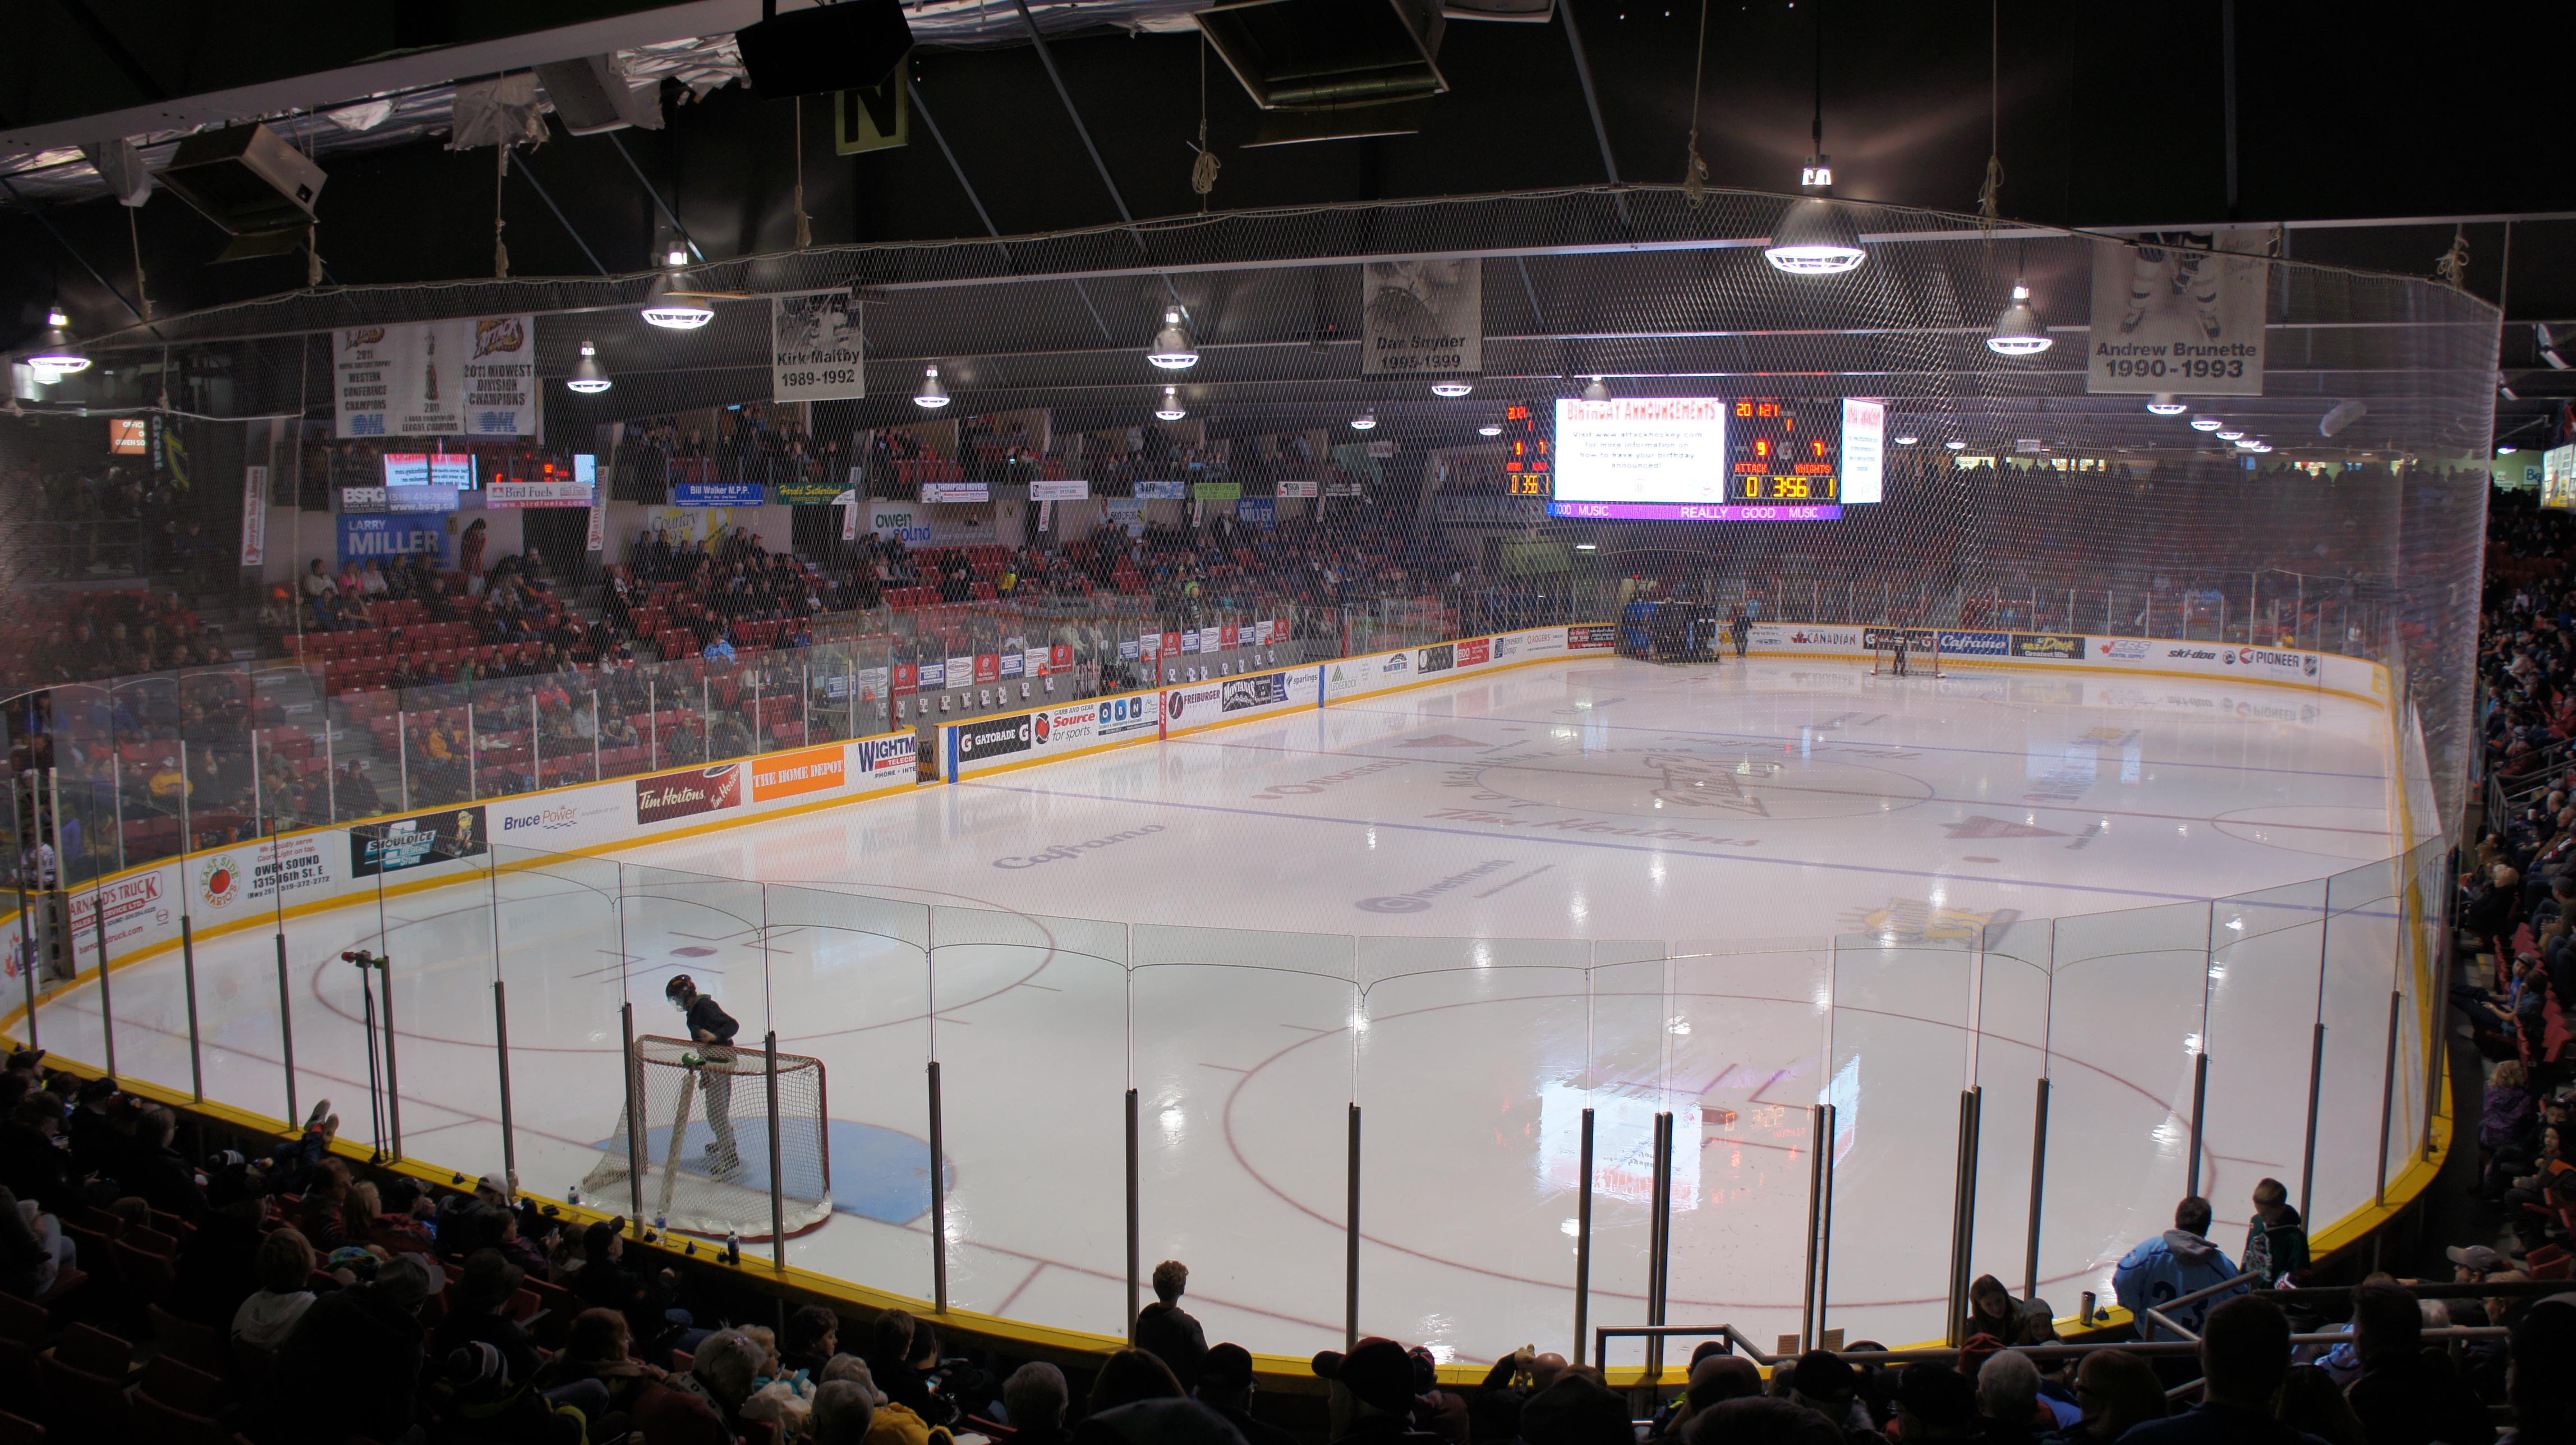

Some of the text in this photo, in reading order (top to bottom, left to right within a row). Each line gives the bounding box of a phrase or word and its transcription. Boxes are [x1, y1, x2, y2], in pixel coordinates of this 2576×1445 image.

[844, 67, 896, 143] N
[1377, 335, 1466, 351] Dan Snyder
[2096, 342, 2256, 357] Andrew Brunette
[776, 349, 860, 366] Kirk Maltby
[1382, 355, 1461, 369] 1995-1999
[464, 365, 532, 377] 2011 MIDWEST
[2106, 359, 2243, 378] 1990-1993
[348, 371, 380, 383] WESTERN
[782, 370, 855, 386] 1989-1992
[343, 385, 387, 397] CONFERENCE
[477, 379, 517, 392] DIVISION
[345, 399, 386, 411] CHAMPIONS
[469, 393, 525, 405] CHAMPIONS
[1625, 401, 1715, 420] ANNOUNCEMENTS
[1757, 441, 1765, 455] 9
[1813, 443, 1821, 455] 7
[1735, 463, 1767, 473] ATTACK
[1795, 463, 1832, 473] KNIGHTS
[506, 487, 553, 498] Bird Fuels
[691, 486, 749, 494] Bill Walker M.P.P.
[779, 485, 841, 495] Harold Sutherland
[1746, 477, 1758, 496] 0
[1773, 477, 1807, 496] 3:56
[343, 487, 386, 503] BSRG
[390, 503, 455, 513] www.bsrg.ca
[1111, 511, 1121, 520] 560
[1579, 505, 1609, 516] MUSIC
[1681, 507, 1818, 518] REALLY GOOD MUSIC
[349, 520, 385, 530] LARRY
[652, 512, 696, 533] Country
[876, 513, 912, 528] owen
[349, 531, 439, 555] MILLER
[1504, 636, 1522, 646] Investors
[1532, 634, 1551, 643] ROGERS
[1807, 632, 1856, 645] CANADIAN
[1941, 634, 2007, 650] Caframo
[1459, 647, 1470, 659] BDO
[1504, 646, 1517, 656] Group
[2168, 648, 2216, 660] ski-doo
[2256, 651, 2299, 668] PIONEER
[1293, 673, 1317, 685] sparlings
[1331, 679, 1358, 691] LEDGEROCK
[1184, 689, 1220, 705] FREIBURGER
[1081, 704, 1094, 712] GEAR
[1053, 711, 1096, 728] Source
[961, 724, 1029, 752] G GATORADE G
[1052, 729, 1065, 741] for
[1066, 725, 1091, 741] sports
[753, 760, 844, 788] THE HOME DEPOT
[875, 770, 896, 779] PHONE
[1305, 760, 1411, 785] ROGERS
[639, 790, 661, 810] Tim
[710, 792, 724, 809] Tim
[504, 814, 540, 830] Bruce
[542, 806, 577, 823] Power
[1423, 808, 1760, 846] Tim Hortons
[271, 840, 293, 852] poudly
[296, 837, 313, 846] serve
[370, 831, 434, 851] SHOULDICE
[992, 824, 1166, 870] Caframo
[257, 853, 275, 862] Coors
[278, 849, 292, 859] Light
[400, 855, 421, 866] STONE
[201, 857, 238, 886] EAST SIDE
[255, 855, 320, 877] OWEN SOUND
[253, 866, 323, 889] 1315 16th St. E
[281, 876, 330, 892] 519-372-2772
[118, 877, 158, 899] TRUCK
[204, 884, 237, 906] MARIO'S
